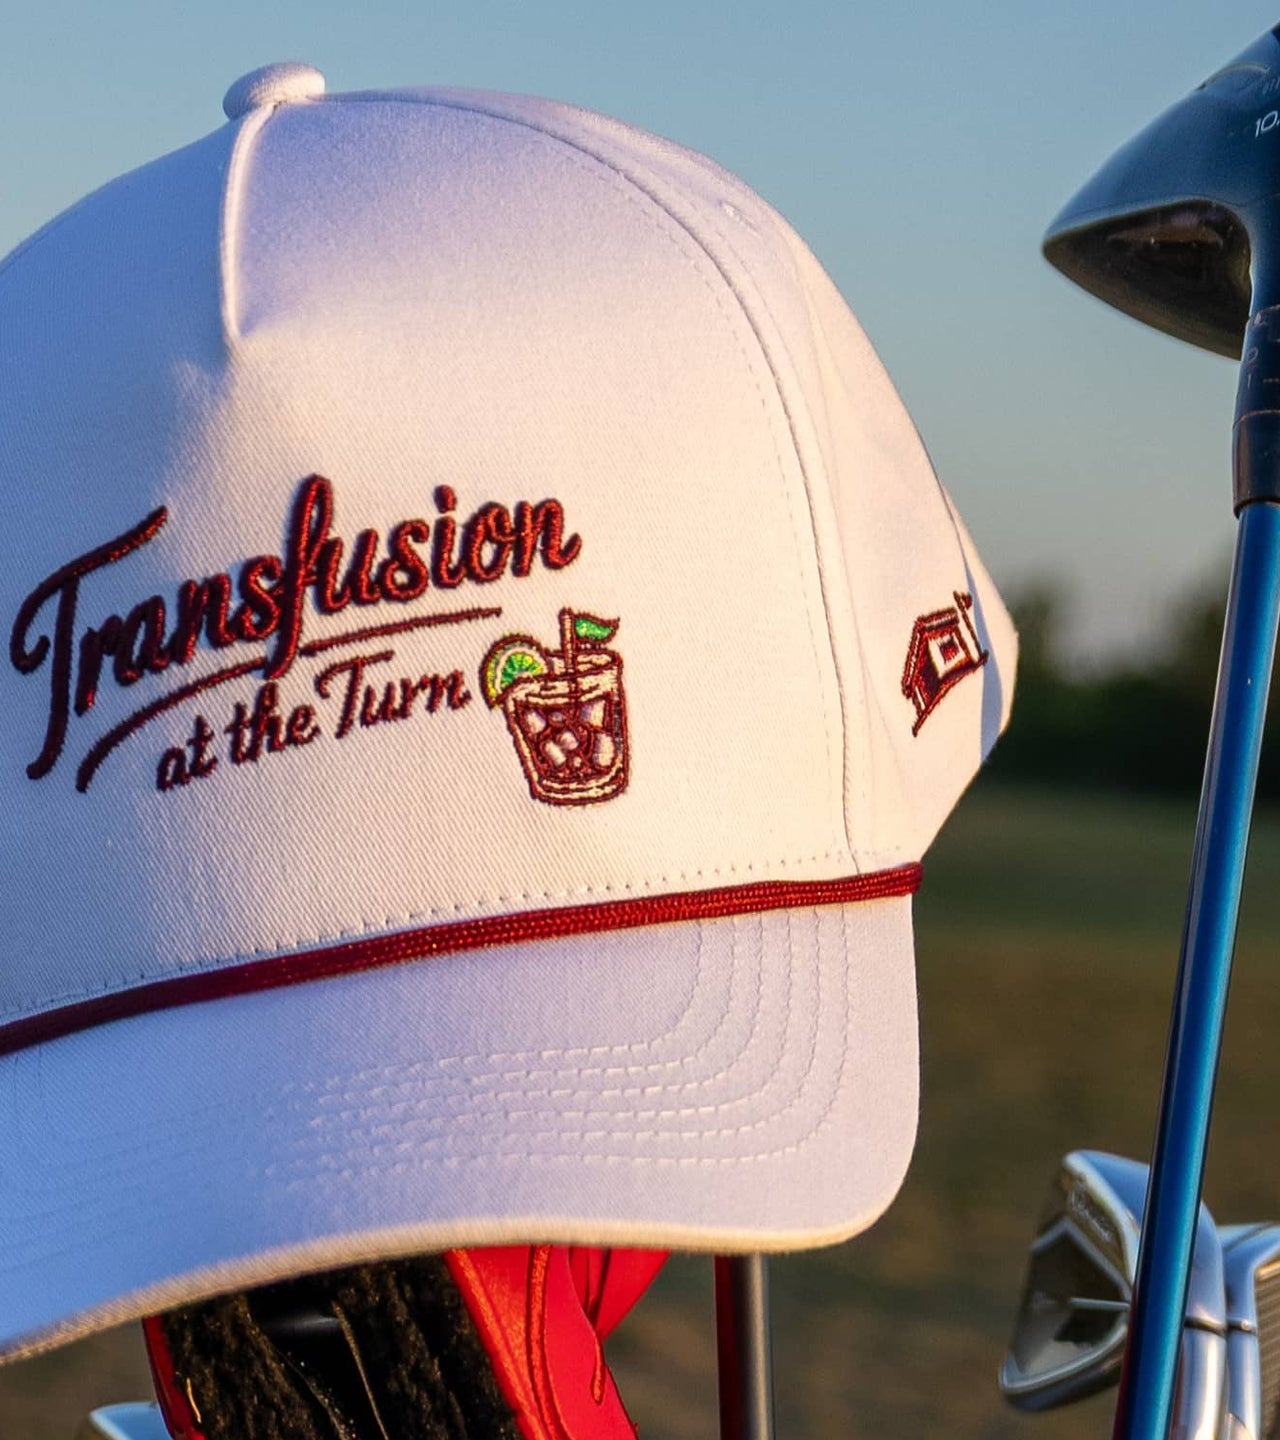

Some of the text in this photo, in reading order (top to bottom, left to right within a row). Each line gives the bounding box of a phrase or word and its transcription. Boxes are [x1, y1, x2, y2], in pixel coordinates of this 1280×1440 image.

[9, 473, 581, 780] Transfusion
[156, 649, 471, 791] at the Turn
